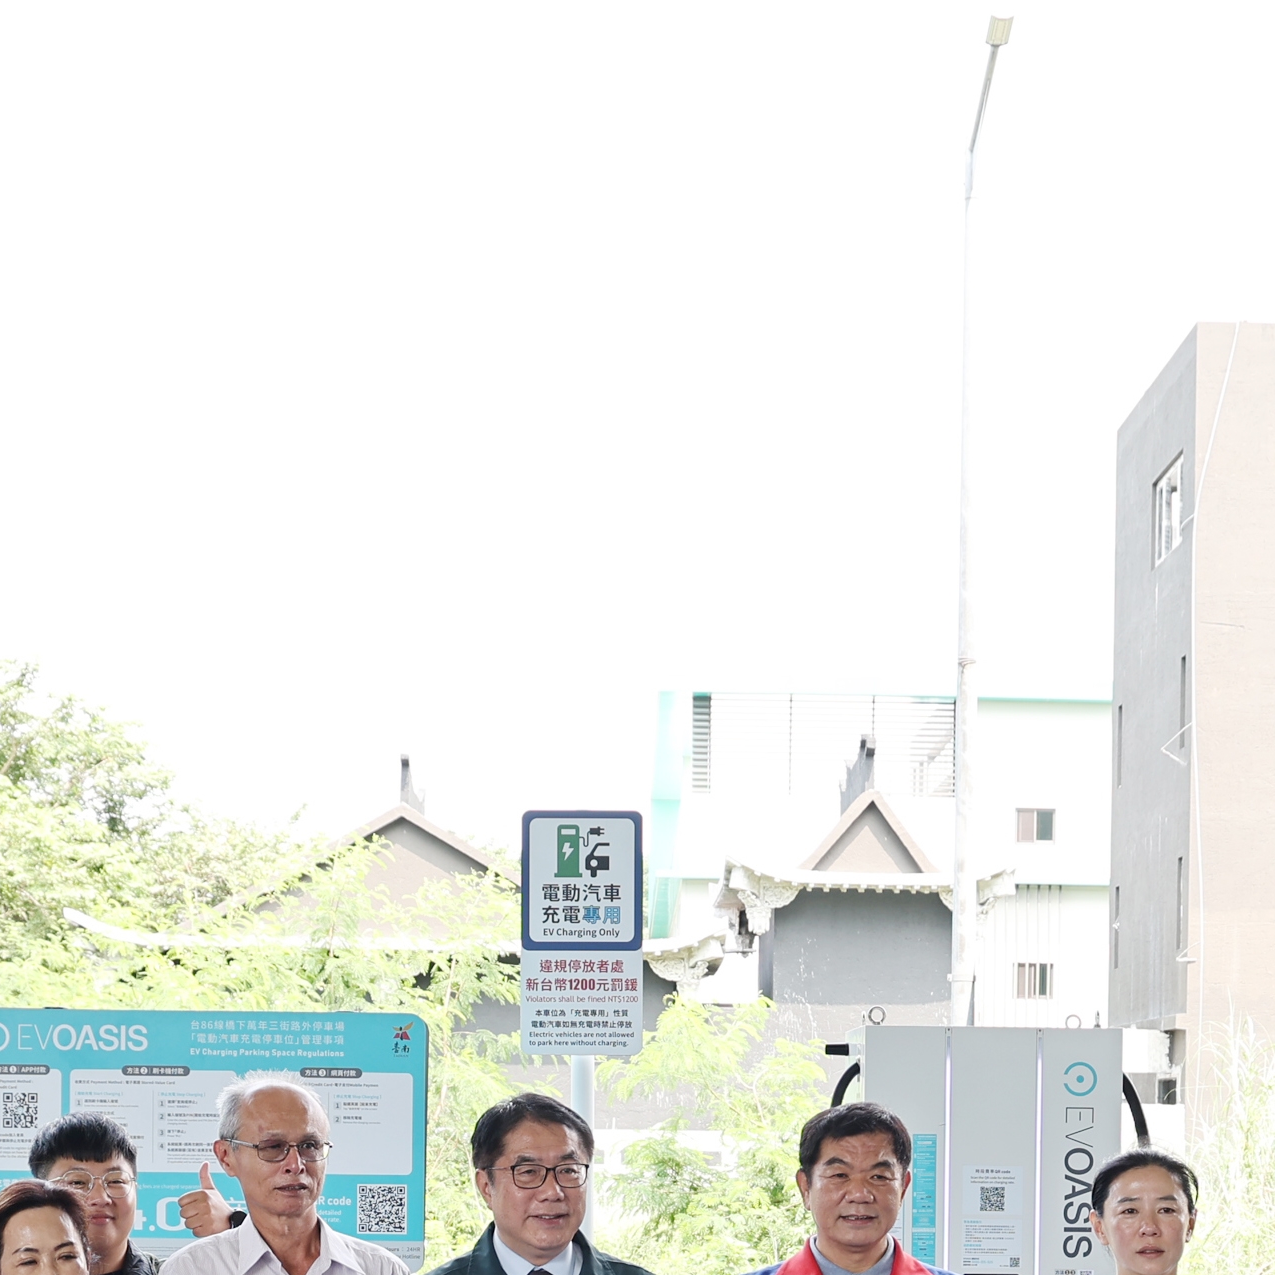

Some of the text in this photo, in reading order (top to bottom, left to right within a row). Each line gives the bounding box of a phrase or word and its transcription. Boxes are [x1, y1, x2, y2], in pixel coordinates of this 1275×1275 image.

[542, 883, 621, 903] 電動汽車
[541, 905, 621, 925] 充電專用
[543, 928, 620, 938] EV Charging Only
[539, 958, 624, 974] 違規停放者處
[525, 995, 639, 1003] Violators shall be fined NT$1200
[18, 1023, 148, 1051] EVOASIS
[597, 1039, 629, 1047] charging.
[202, 1048, 238, 1058] Charging
[239, 1048, 270, 1058] Parking
[271, 1049, 296, 1059] Space
[297, 1049, 345, 1059] Regulations
[1062, 1106, 1094, 1259] EVOASIS
[327, 1196, 352, 1206] code
